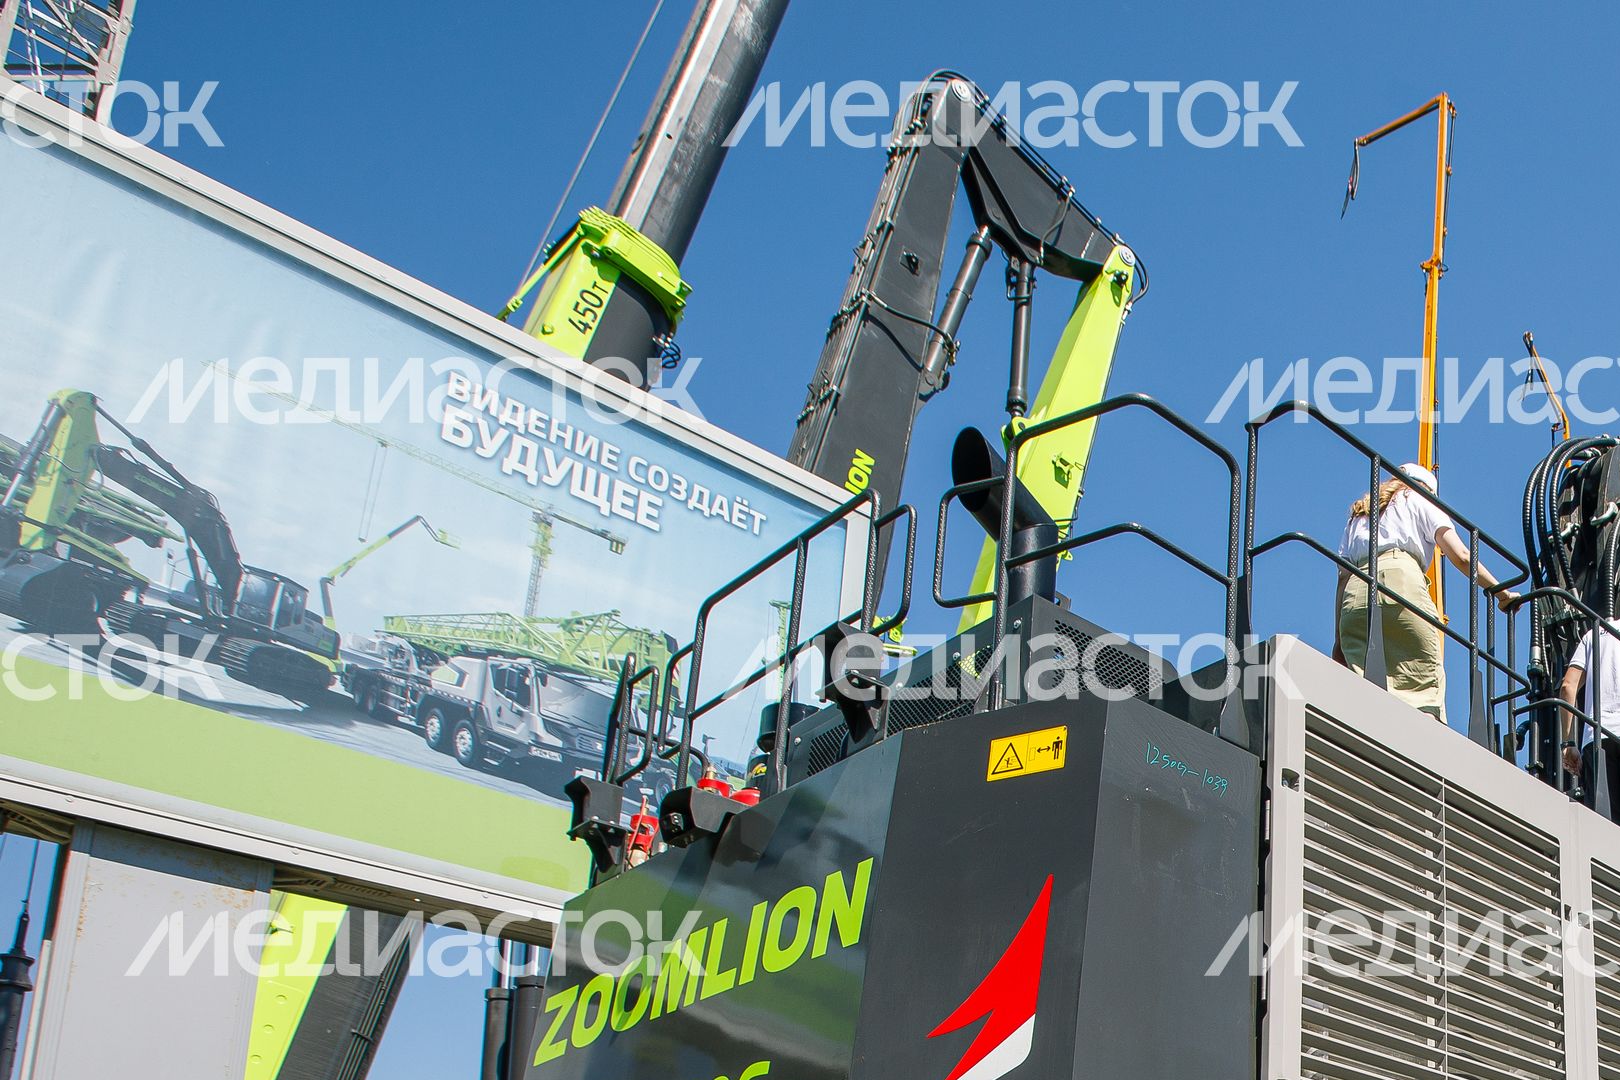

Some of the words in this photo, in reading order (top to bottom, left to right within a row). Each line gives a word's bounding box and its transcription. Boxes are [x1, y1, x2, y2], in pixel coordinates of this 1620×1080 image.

[441, 405, 667, 533] БУДУЩЕЕ
[446, 371, 622, 473] ВИДЕНИЕ
[627, 455, 767, 536] СОЗДАЁТ
[532, 857, 875, 1068] ZOOMLION
